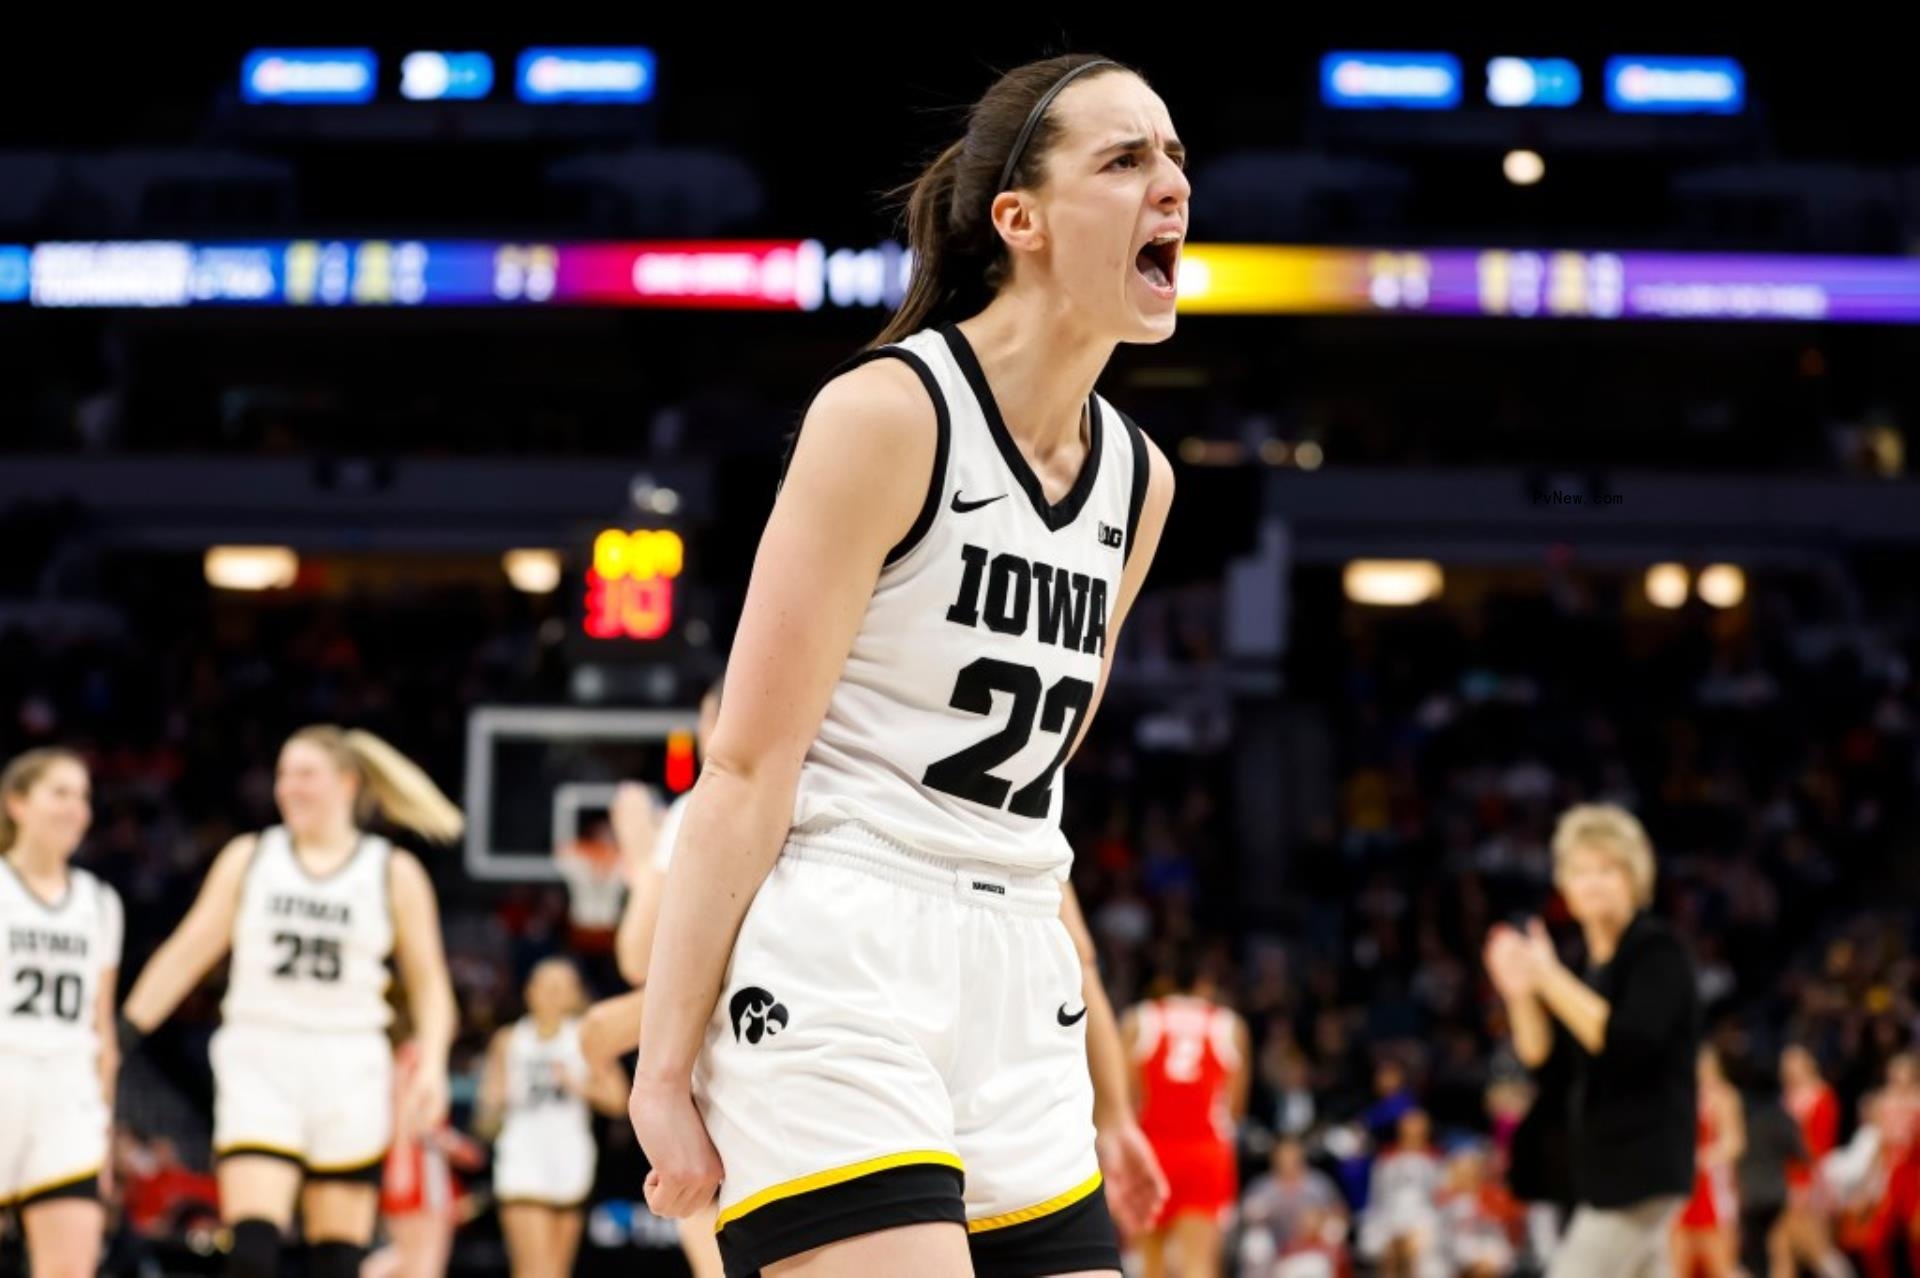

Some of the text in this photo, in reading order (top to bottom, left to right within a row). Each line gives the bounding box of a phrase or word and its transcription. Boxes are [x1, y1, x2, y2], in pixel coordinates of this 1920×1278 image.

[946, 543, 1107, 658] IOWA
[922, 657, 1094, 819] 22
[11, 967, 82, 1022] 20
[272, 932, 342, 982] 25
